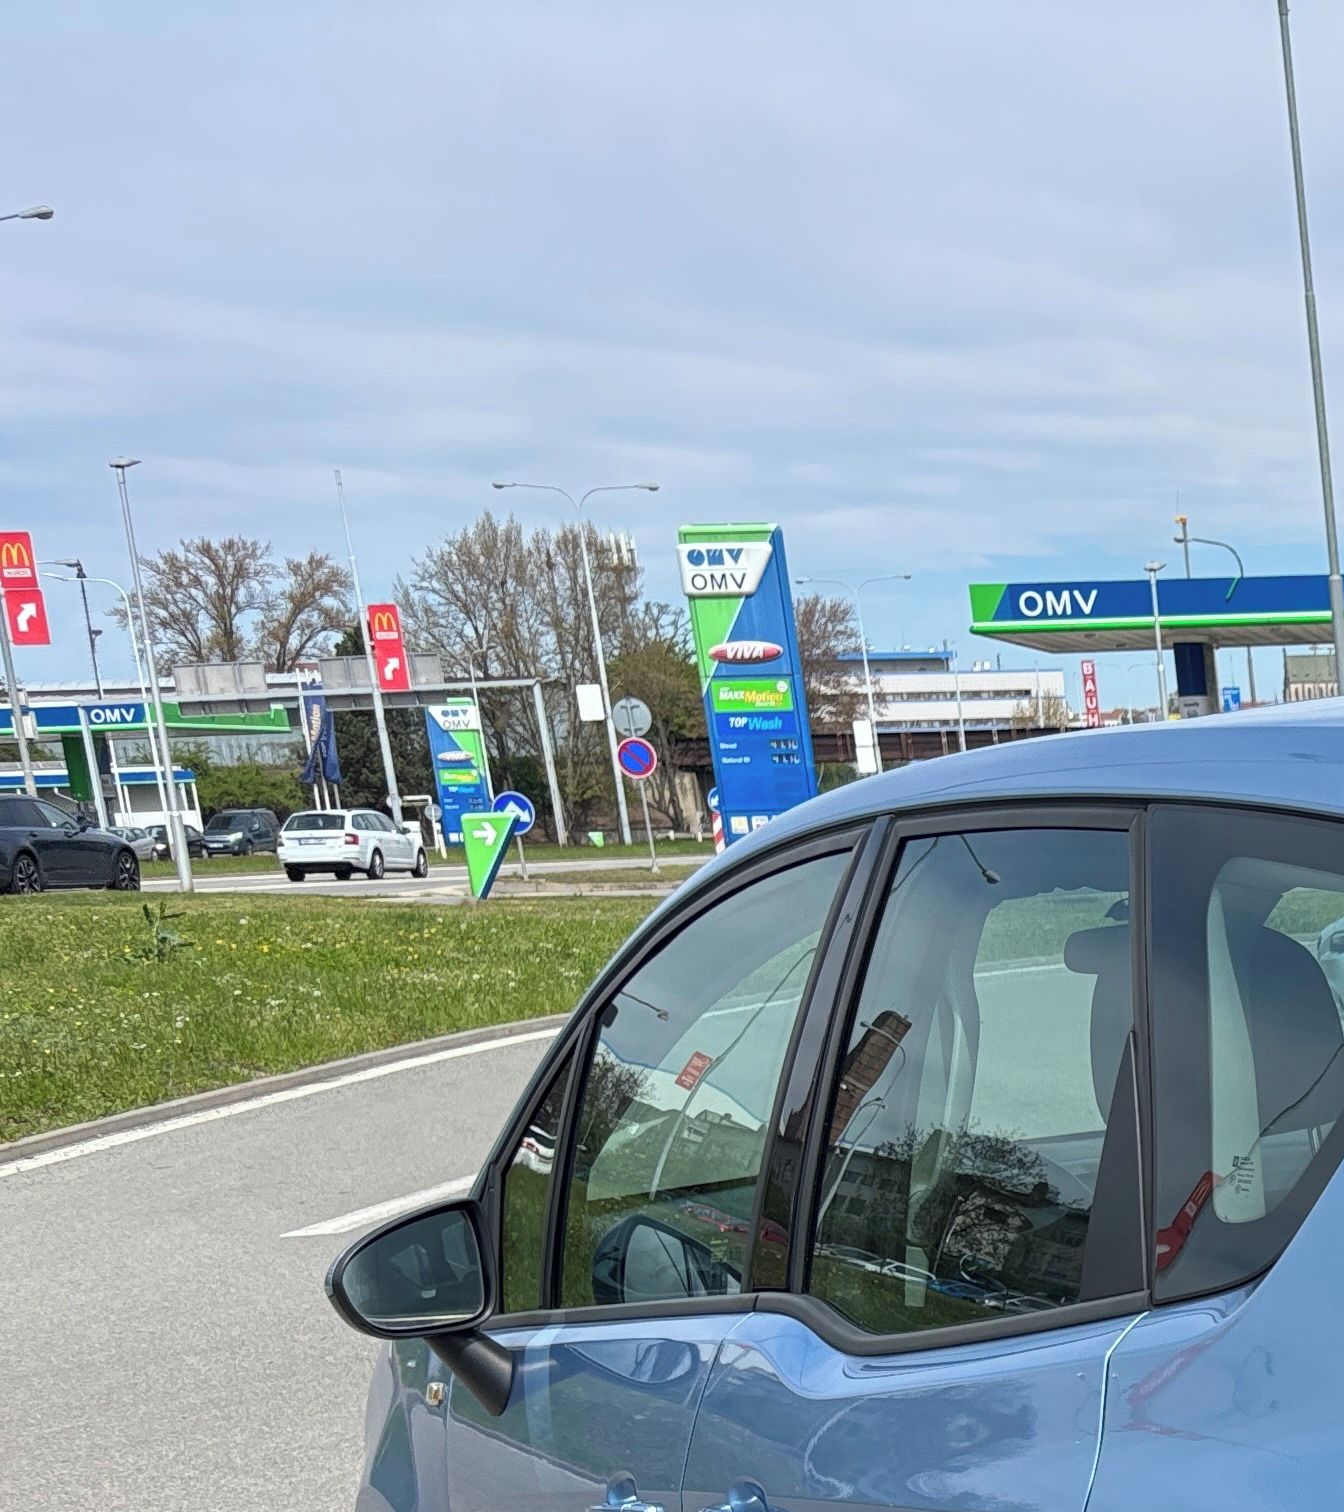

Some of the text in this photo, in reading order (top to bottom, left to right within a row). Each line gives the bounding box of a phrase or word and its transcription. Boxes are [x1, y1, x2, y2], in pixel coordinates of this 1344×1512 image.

[691, 572, 747, 591] OMV
[1019, 589, 1098, 617] OMV
[726, 645, 765, 660] VIVA
[90, 708, 135, 723] OMV
[442, 719, 471, 729] OMV
